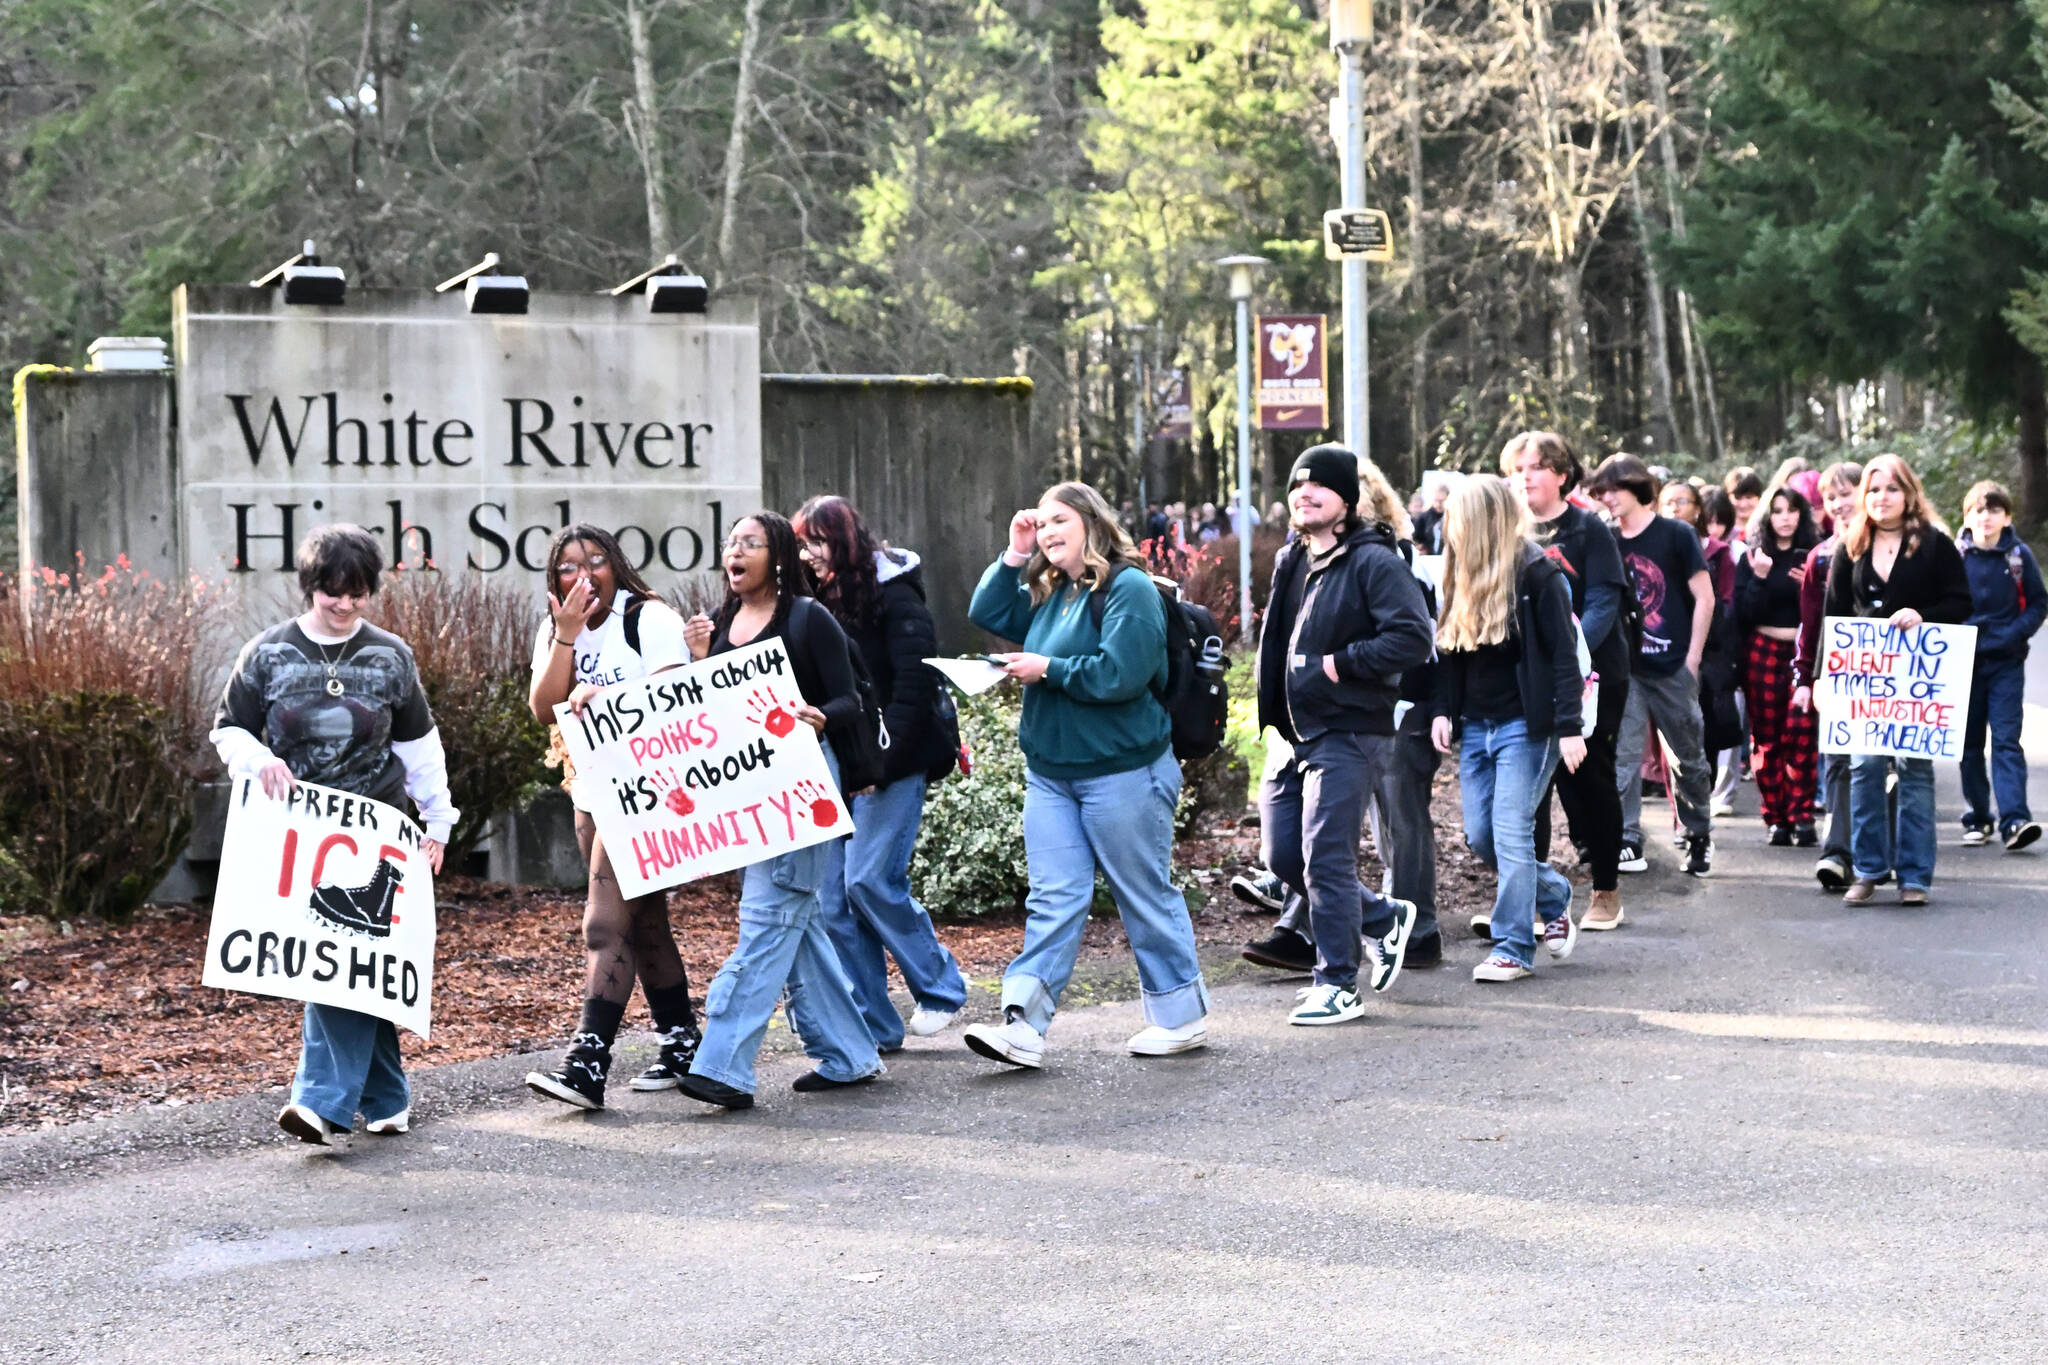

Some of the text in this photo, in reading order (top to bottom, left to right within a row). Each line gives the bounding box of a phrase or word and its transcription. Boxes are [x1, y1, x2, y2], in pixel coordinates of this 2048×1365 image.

[225, 391, 713, 468] White River
[227, 500, 440, 572] Hh
[1834, 622, 1948, 656] STAYING
[711, 648, 785, 690] about
[1828, 651, 1941, 680] SILENT IN
[1828, 672, 1946, 700] TIMES OF
[1851, 698, 1954, 727] INJUSTICE
[1828, 721, 1852, 746] IS
[685, 738, 775, 789] about
[242, 779, 251, 808] I
[632, 791, 795, 880] HUMANITY
[220, 929, 418, 1008] CRUSHED
